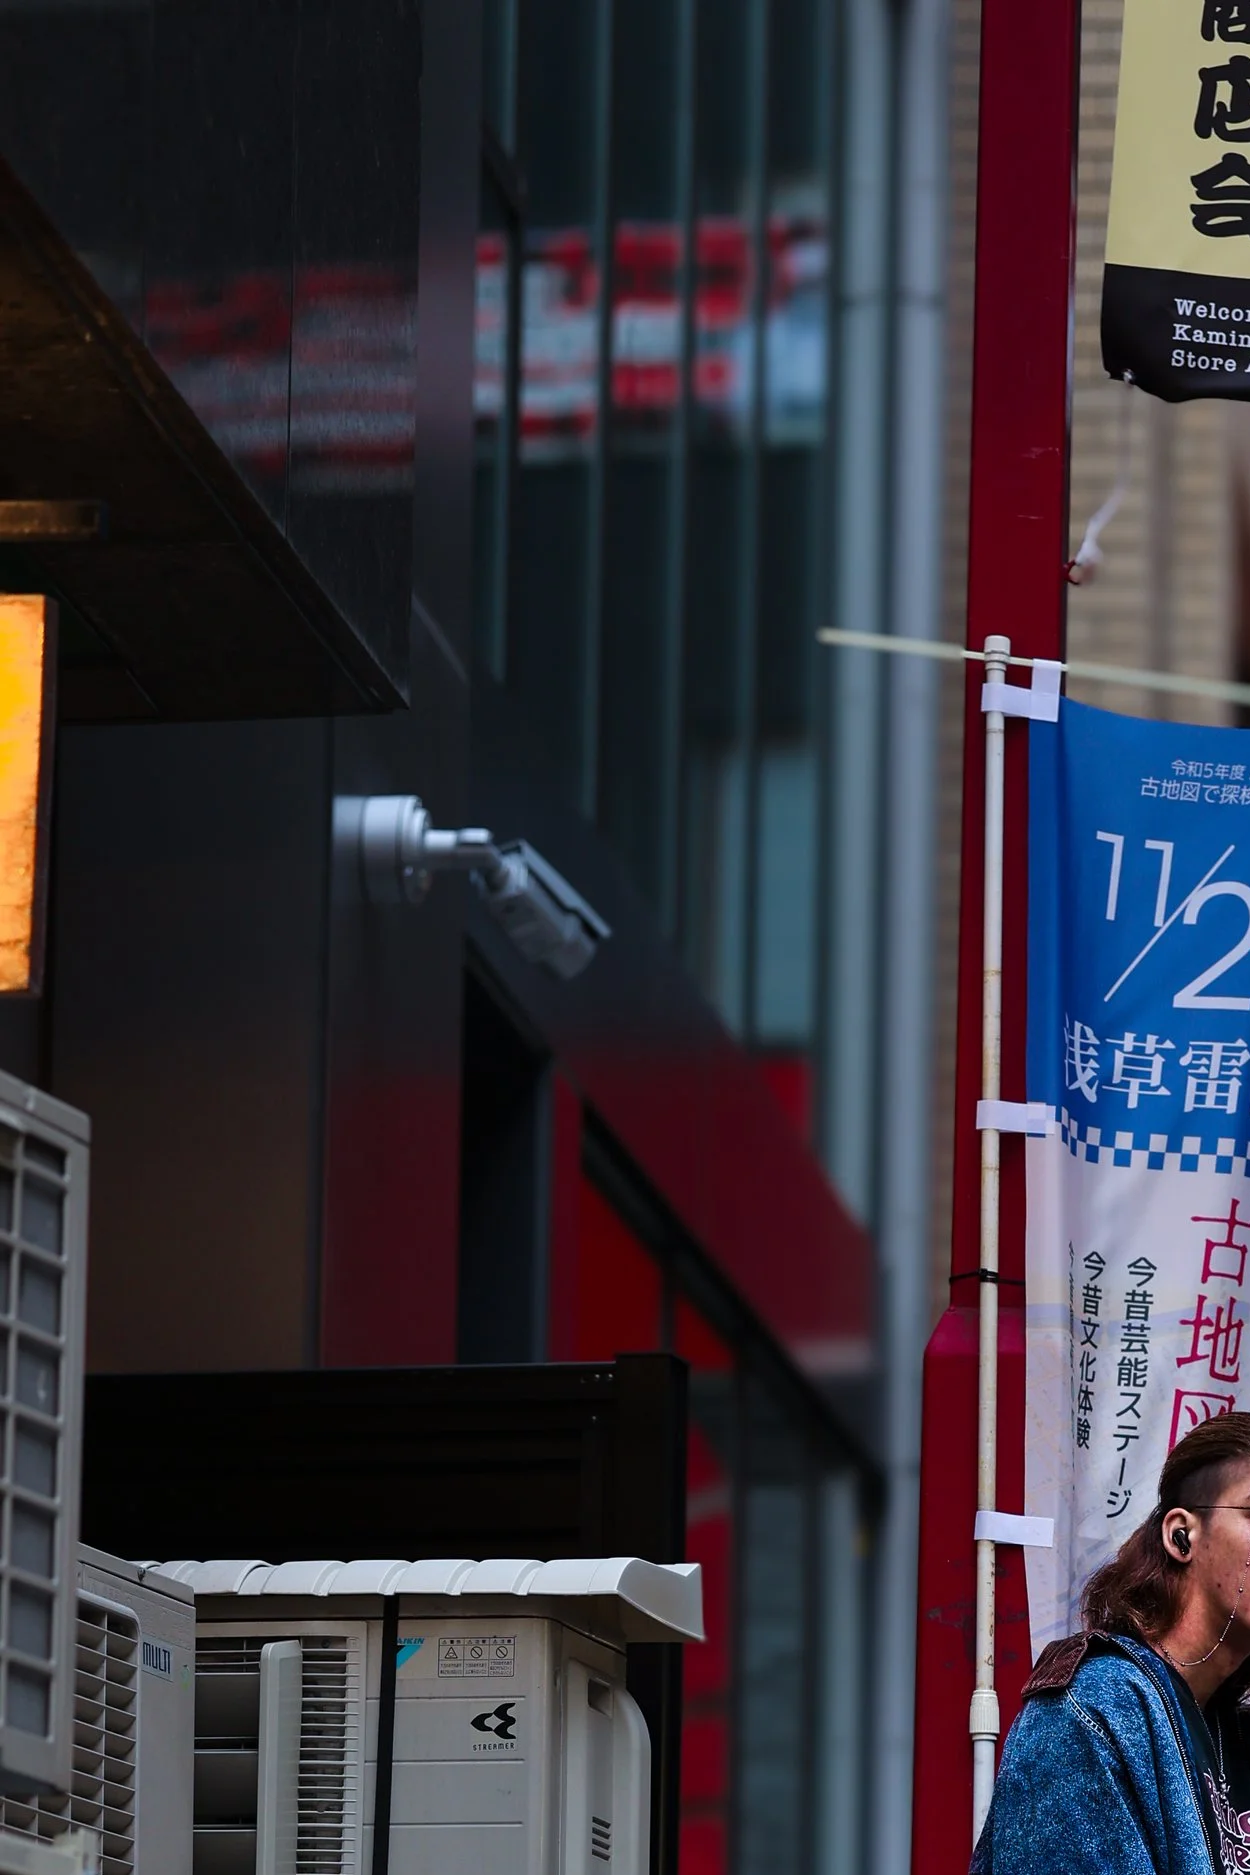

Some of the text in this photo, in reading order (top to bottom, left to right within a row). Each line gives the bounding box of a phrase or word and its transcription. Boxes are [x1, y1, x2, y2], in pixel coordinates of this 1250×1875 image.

[1171, 349, 1237, 372] Store
[1171, 759, 1246, 782] 令和5年度
[1076, 1250, 1106, 1450] 今昔文化体験
[1106, 1256, 1158, 1519] 今昔芸能ステージ
[142, 1641, 171, 1675] MULTI
[472, 1742, 515, 1752] STREAMER
